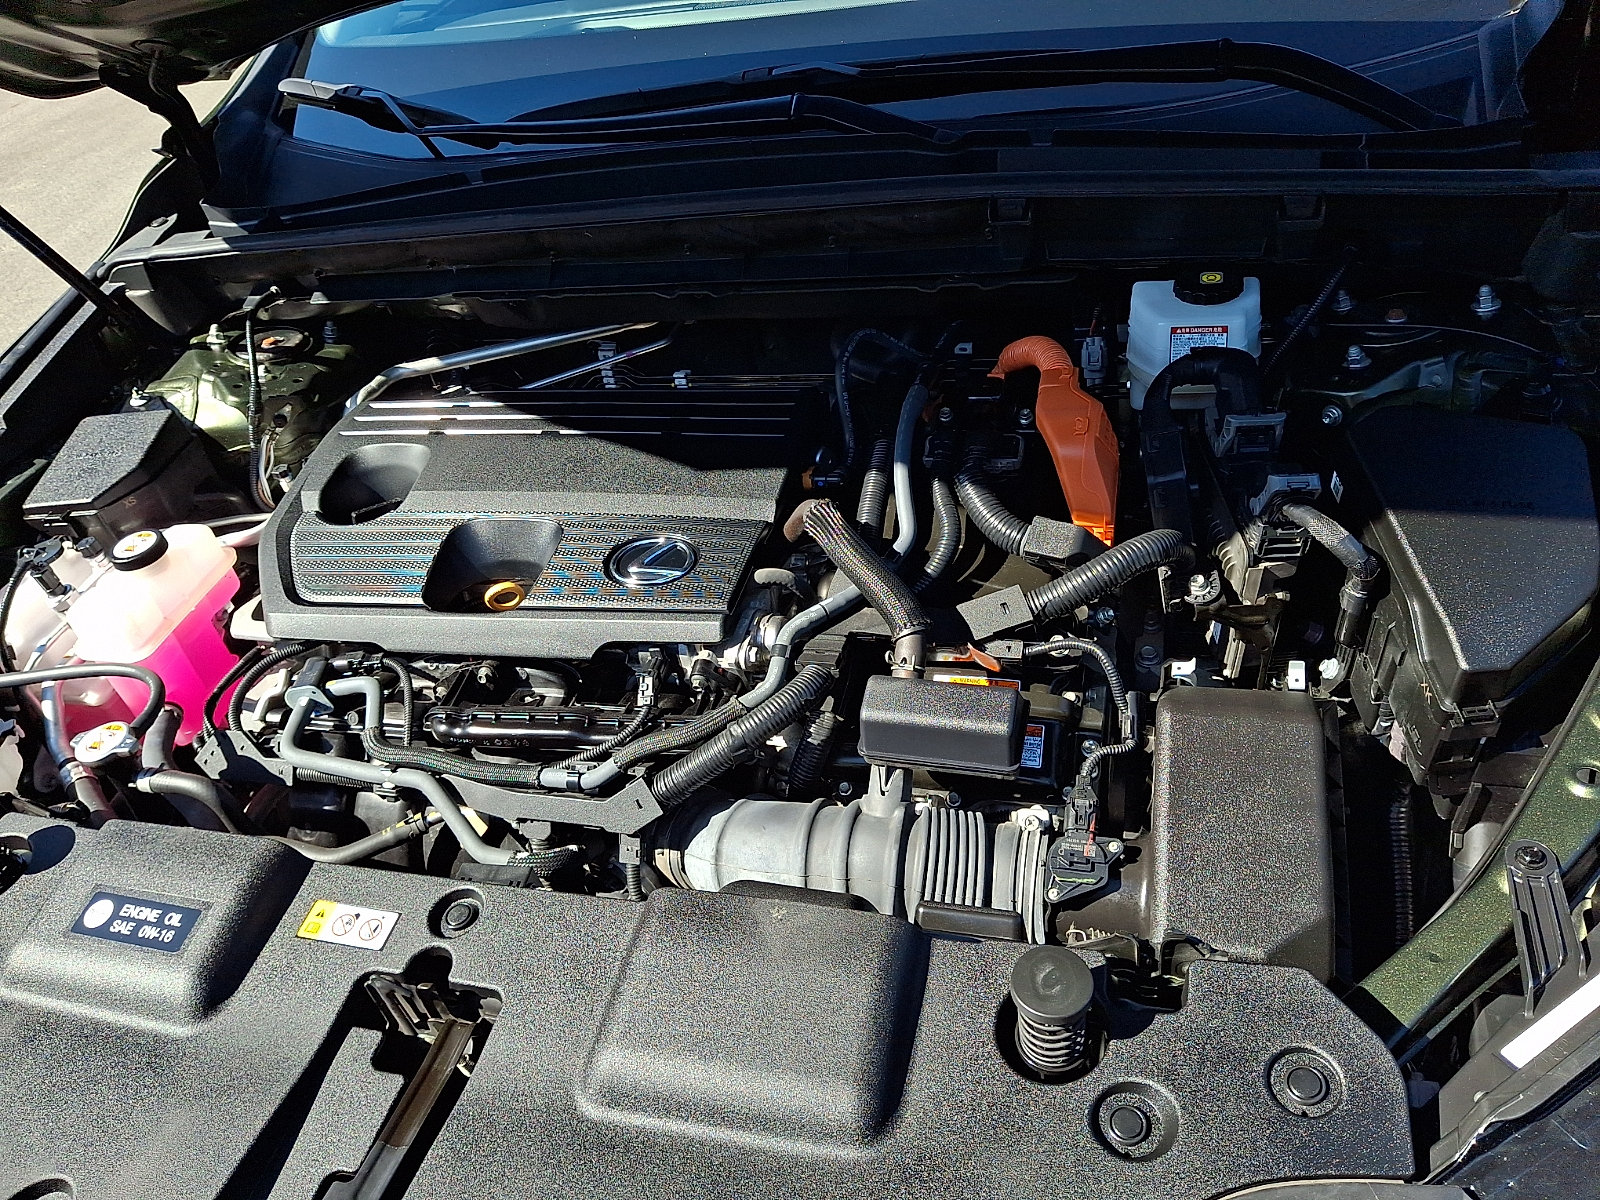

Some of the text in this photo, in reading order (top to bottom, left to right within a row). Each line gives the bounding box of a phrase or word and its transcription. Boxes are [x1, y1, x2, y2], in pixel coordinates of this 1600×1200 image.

[119, 904, 182, 927] ENGINE OIL
[109, 920, 175, 943] SAE 0W-16
